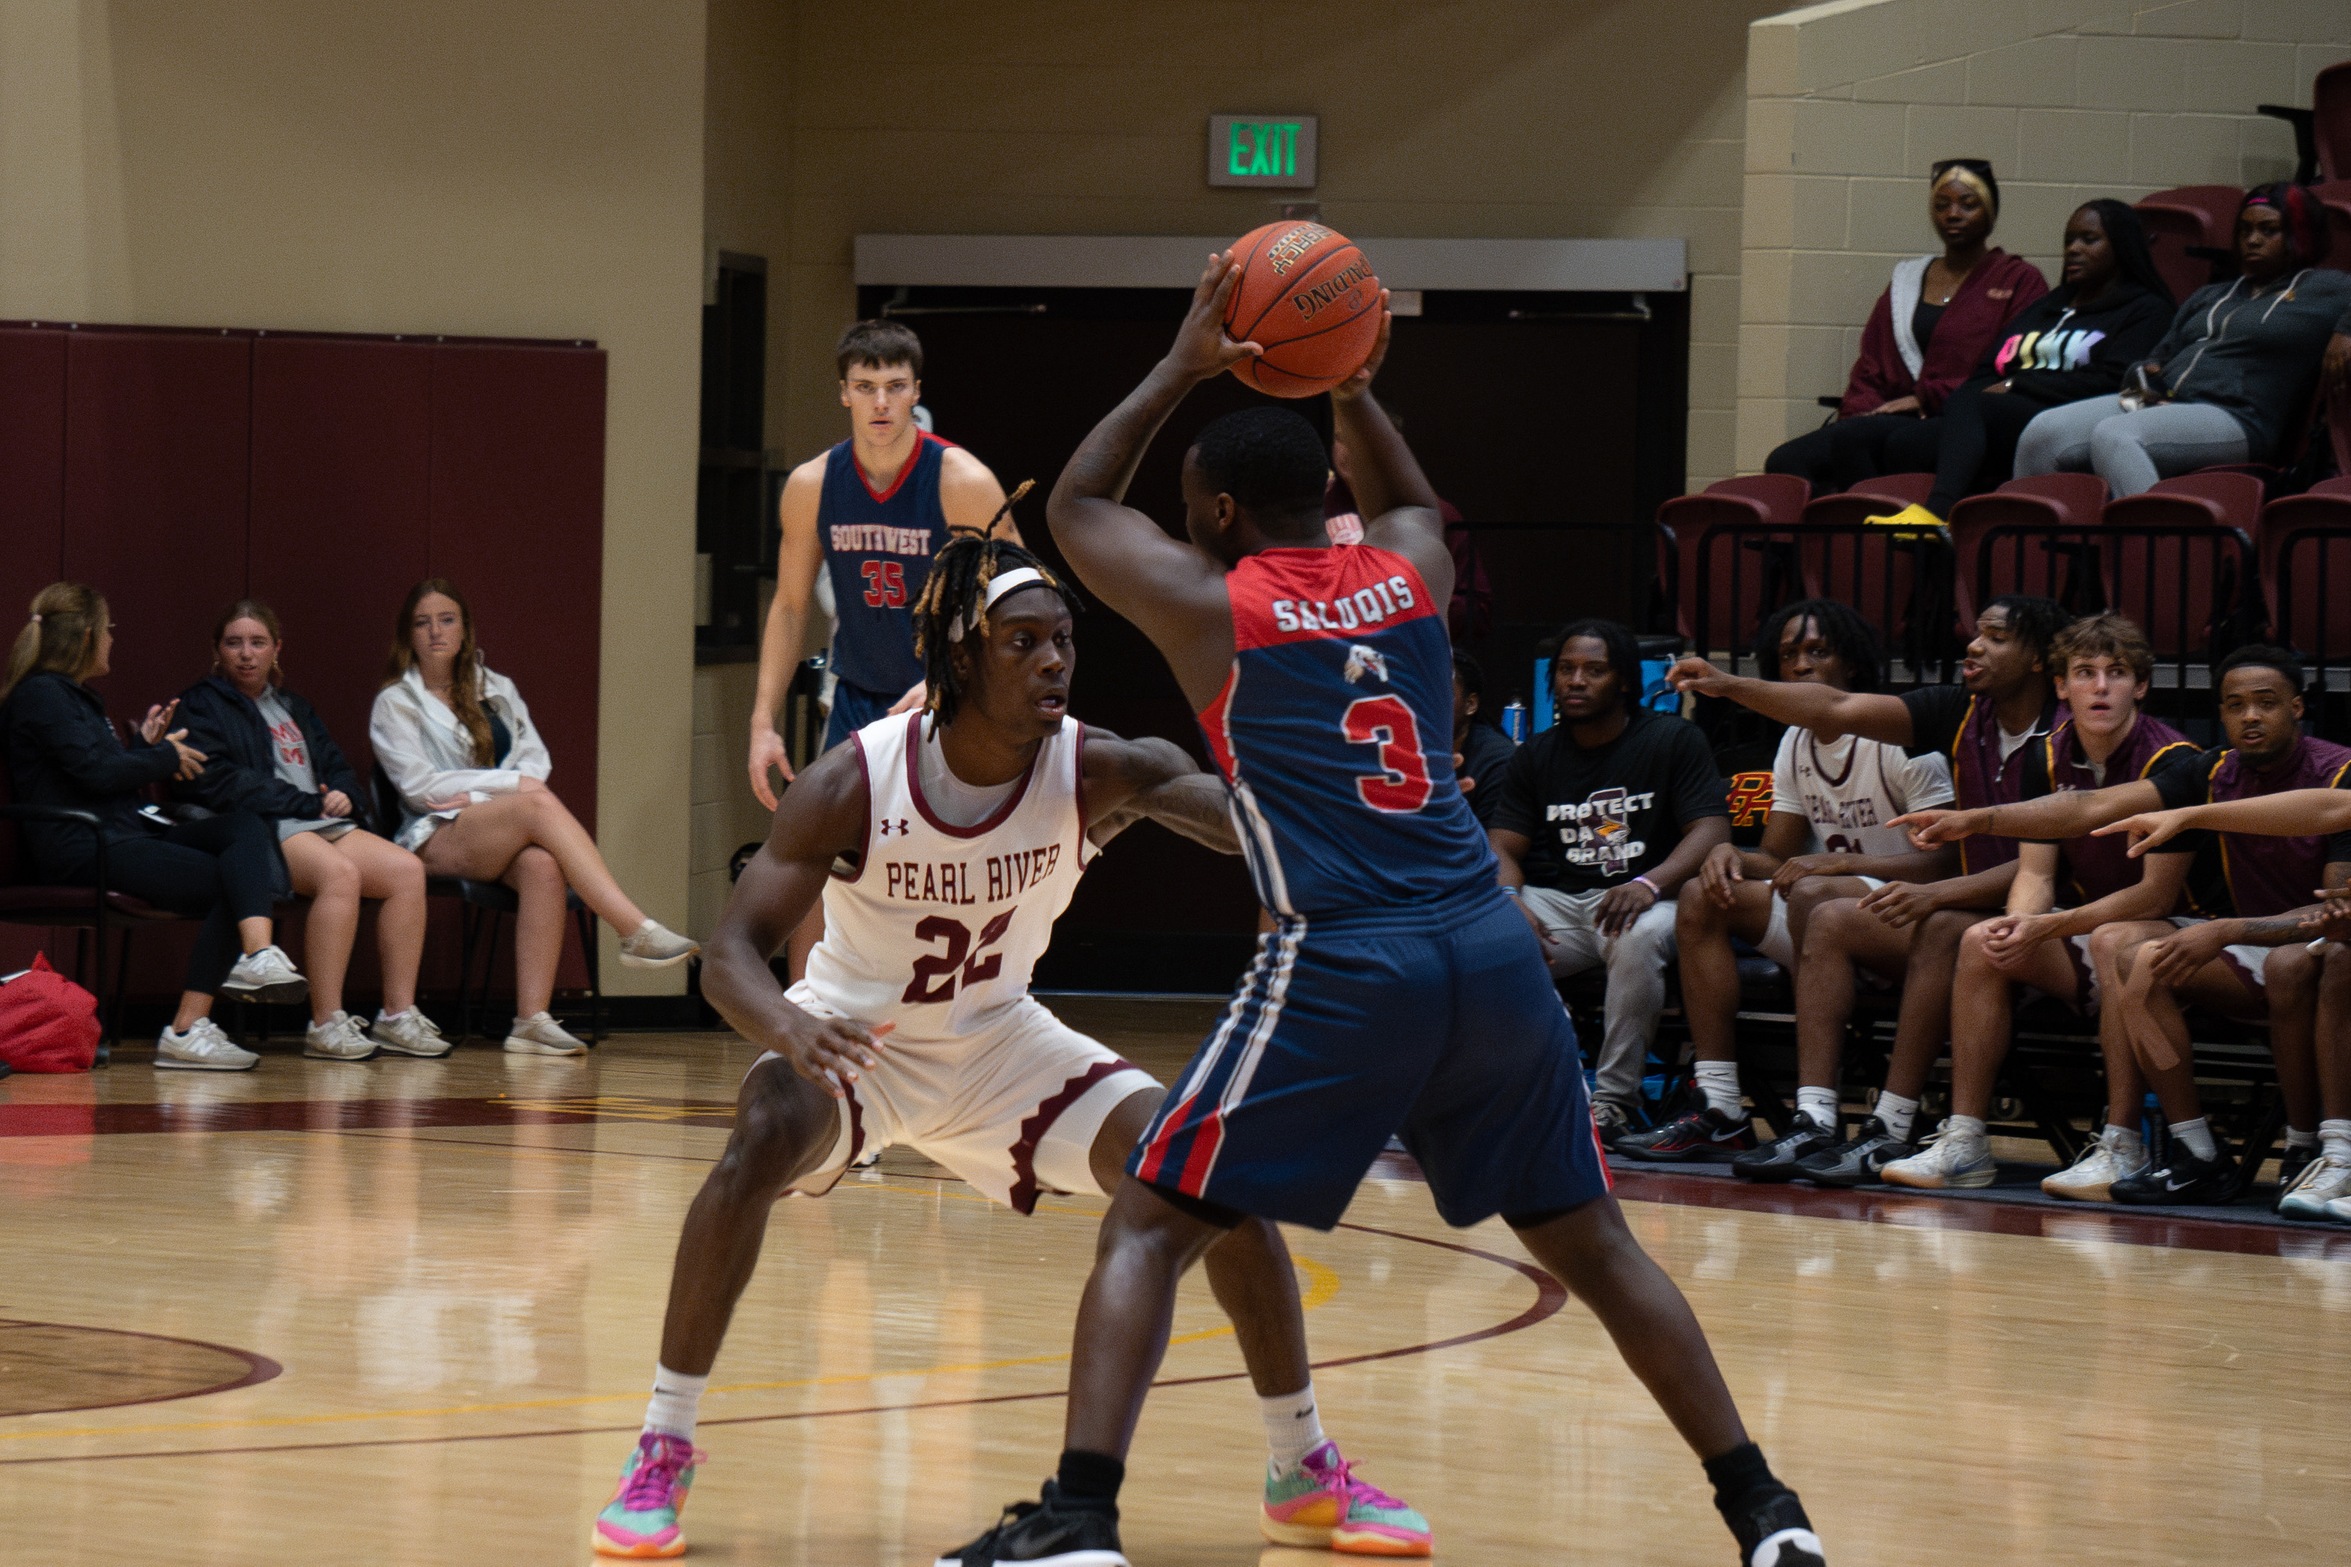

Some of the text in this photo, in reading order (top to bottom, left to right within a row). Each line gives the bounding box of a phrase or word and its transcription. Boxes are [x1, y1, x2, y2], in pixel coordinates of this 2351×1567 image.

[1228, 122, 1301, 176] EXIT
[1293, 255, 1374, 320] PALDING
[1994, 330, 2107, 376] PINK
[861, 560, 908, 609] 35
[1272, 575, 1415, 633] SALUQIS
[1340, 694, 1434, 813] 3
[1546, 792, 1655, 822] PROTECT
[1560, 826, 1595, 844] DA
[1565, 841, 1647, 863] GRAND
[886, 843, 1061, 905] PEARL RIVER
[901, 905, 1018, 1004] 22
